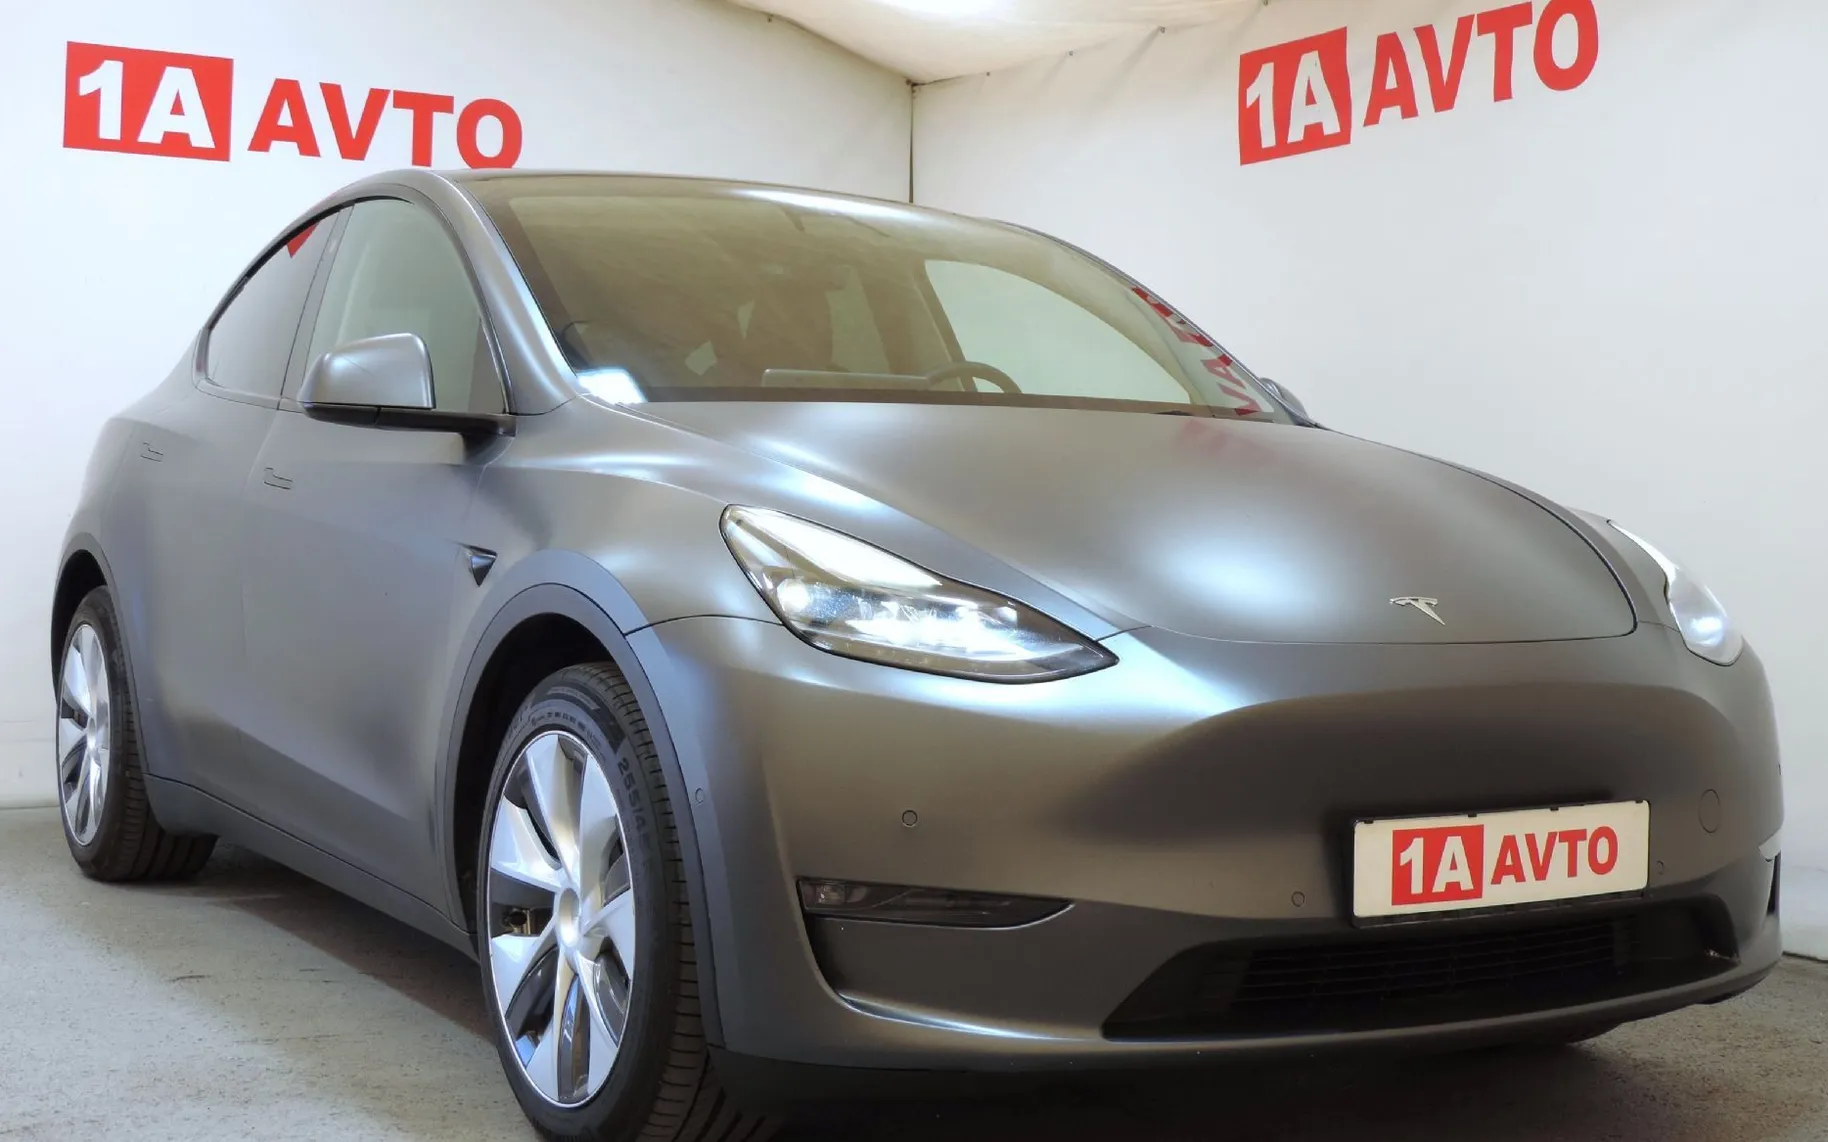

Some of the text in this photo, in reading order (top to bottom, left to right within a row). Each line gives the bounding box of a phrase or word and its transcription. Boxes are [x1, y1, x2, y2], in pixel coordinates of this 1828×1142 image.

[78, 60, 523, 168] 1A AVTO
[1245, 0, 1599, 150] 1A AVTO
[1399, 825, 1619, 896] 1A AVTO
